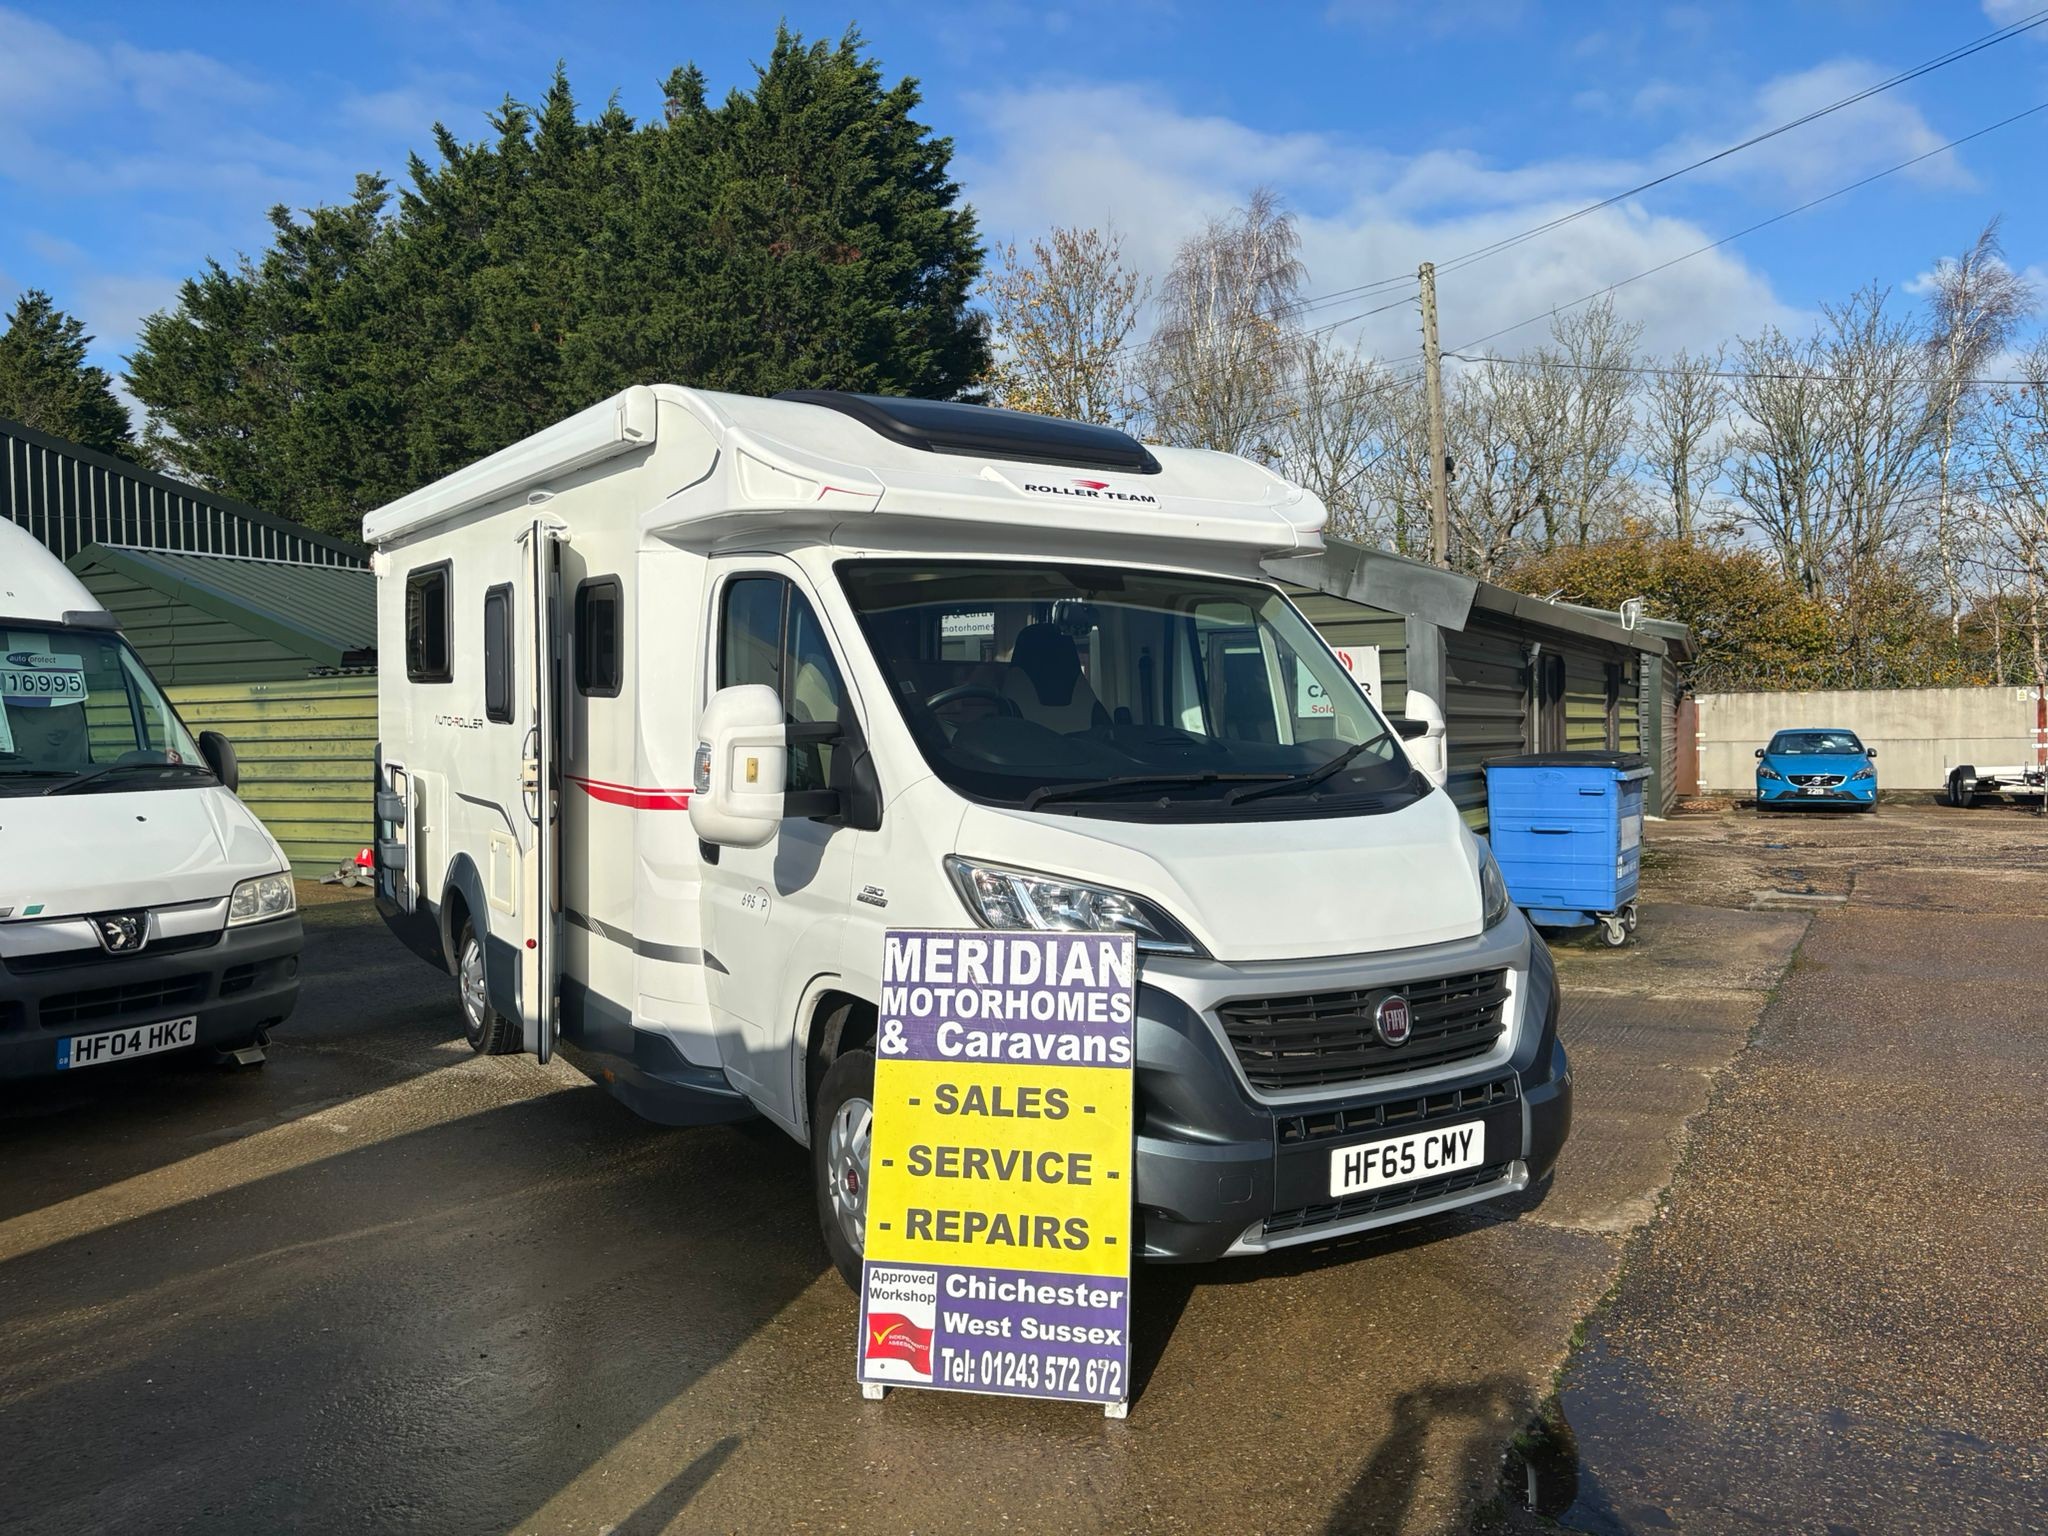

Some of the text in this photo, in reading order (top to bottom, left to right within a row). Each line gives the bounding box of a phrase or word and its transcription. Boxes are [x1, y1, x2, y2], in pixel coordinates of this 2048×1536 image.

[1025, 484, 1156, 502] ROLLER TEAM
[9, 655, 57, 664] auto protect
[9, 674, 81, 692] 16995
[434, 714, 483, 729] AUTO-ROLLER
[741, 893, 768, 911] 695 P
[883, 937, 1132, 988] MERIDIAN
[881, 986, 1132, 1024] MOTORHOMES
[1385, 1008, 1405, 1031] FIAT
[75, 1020, 193, 1062] HF04 HKC
[879, 1019, 1132, 1064] & Caravans
[934, 1083, 1070, 1120] SALES
[907, 1144, 1092, 1185] SERVICE
[1344, 1128, 1474, 1188] HF65 CMY
[905, 1208, 1090, 1250] REPAIRS
[871, 1269, 936, 1285] Approved
[945, 1273, 1124, 1310] Chichester
[869, 1287, 936, 1306] Workshop
[943, 1311, 1122, 1346] West Sussex
[941, 1348, 1122, 1396] Tel: 01243 572 672
